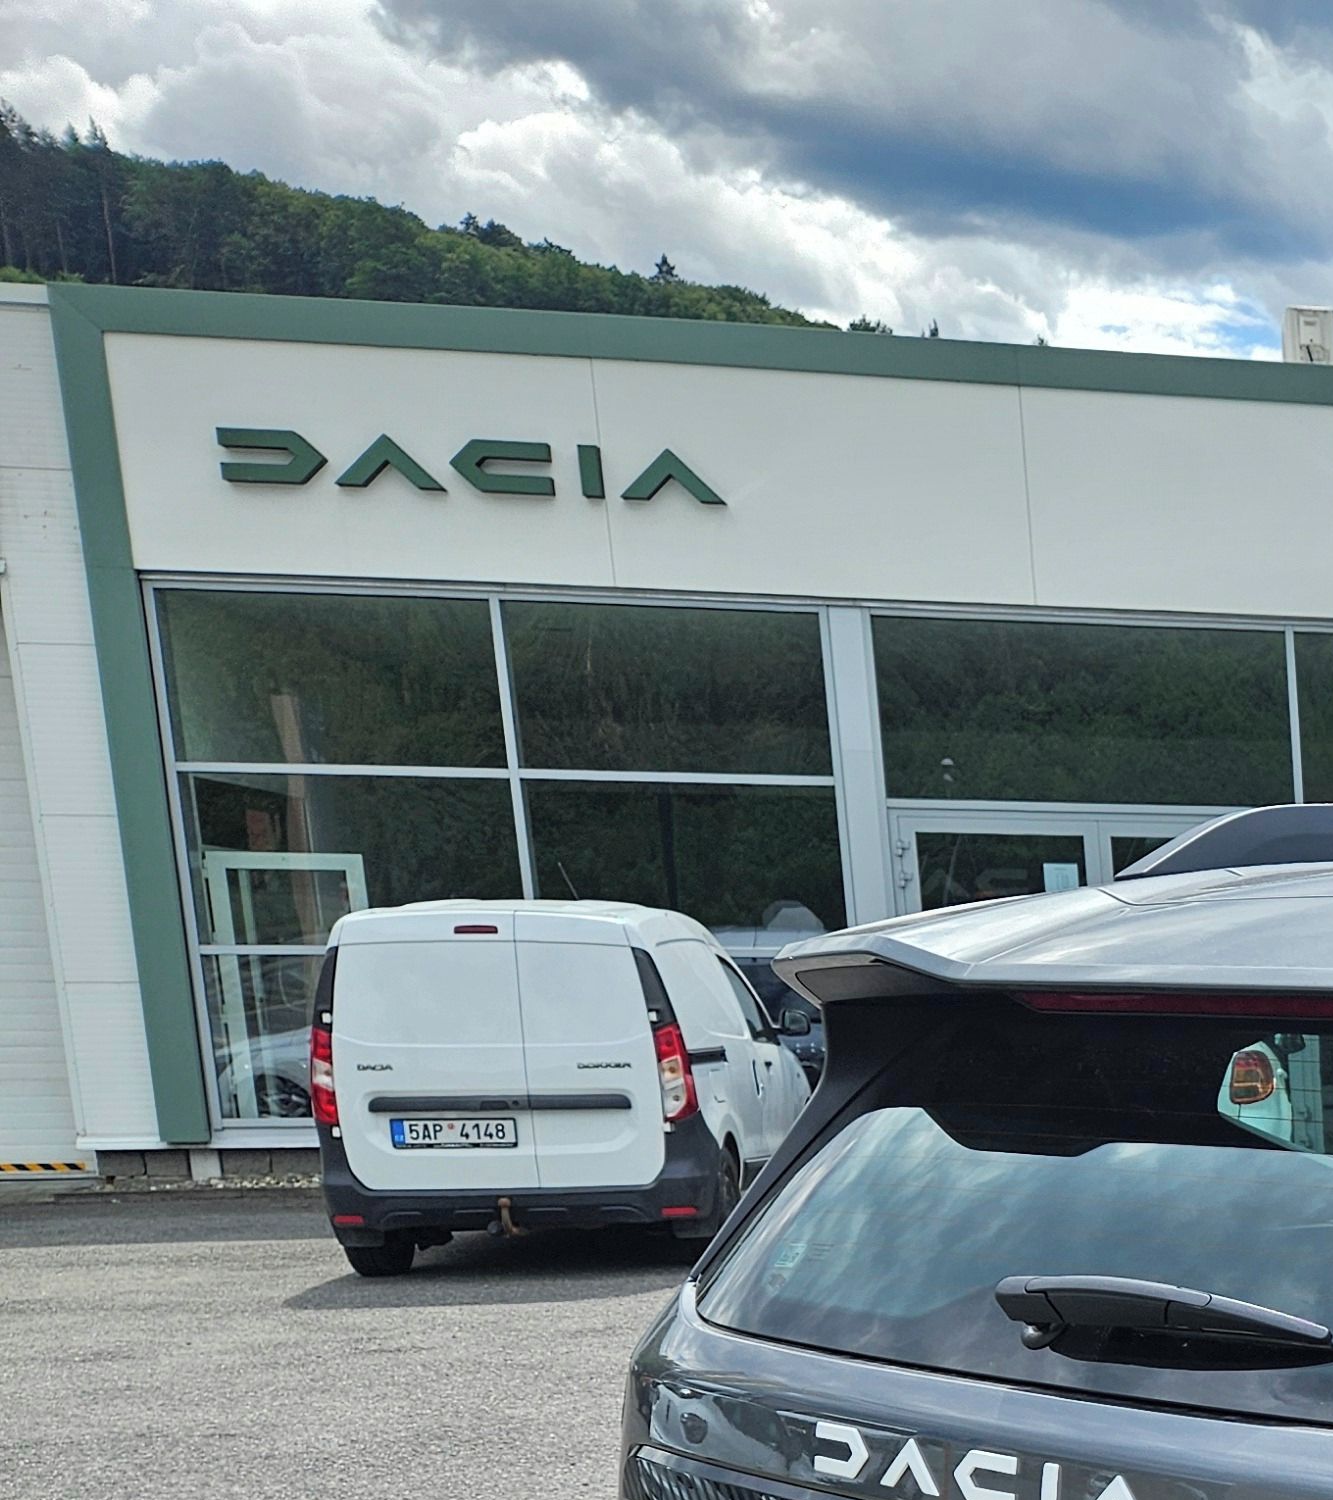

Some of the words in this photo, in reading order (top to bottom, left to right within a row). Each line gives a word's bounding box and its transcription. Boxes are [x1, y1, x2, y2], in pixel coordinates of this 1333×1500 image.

[215, 426, 728, 506] DACIA
[408, 1122, 443, 1141] 5AP
[460, 1122, 506, 1140] 4148
